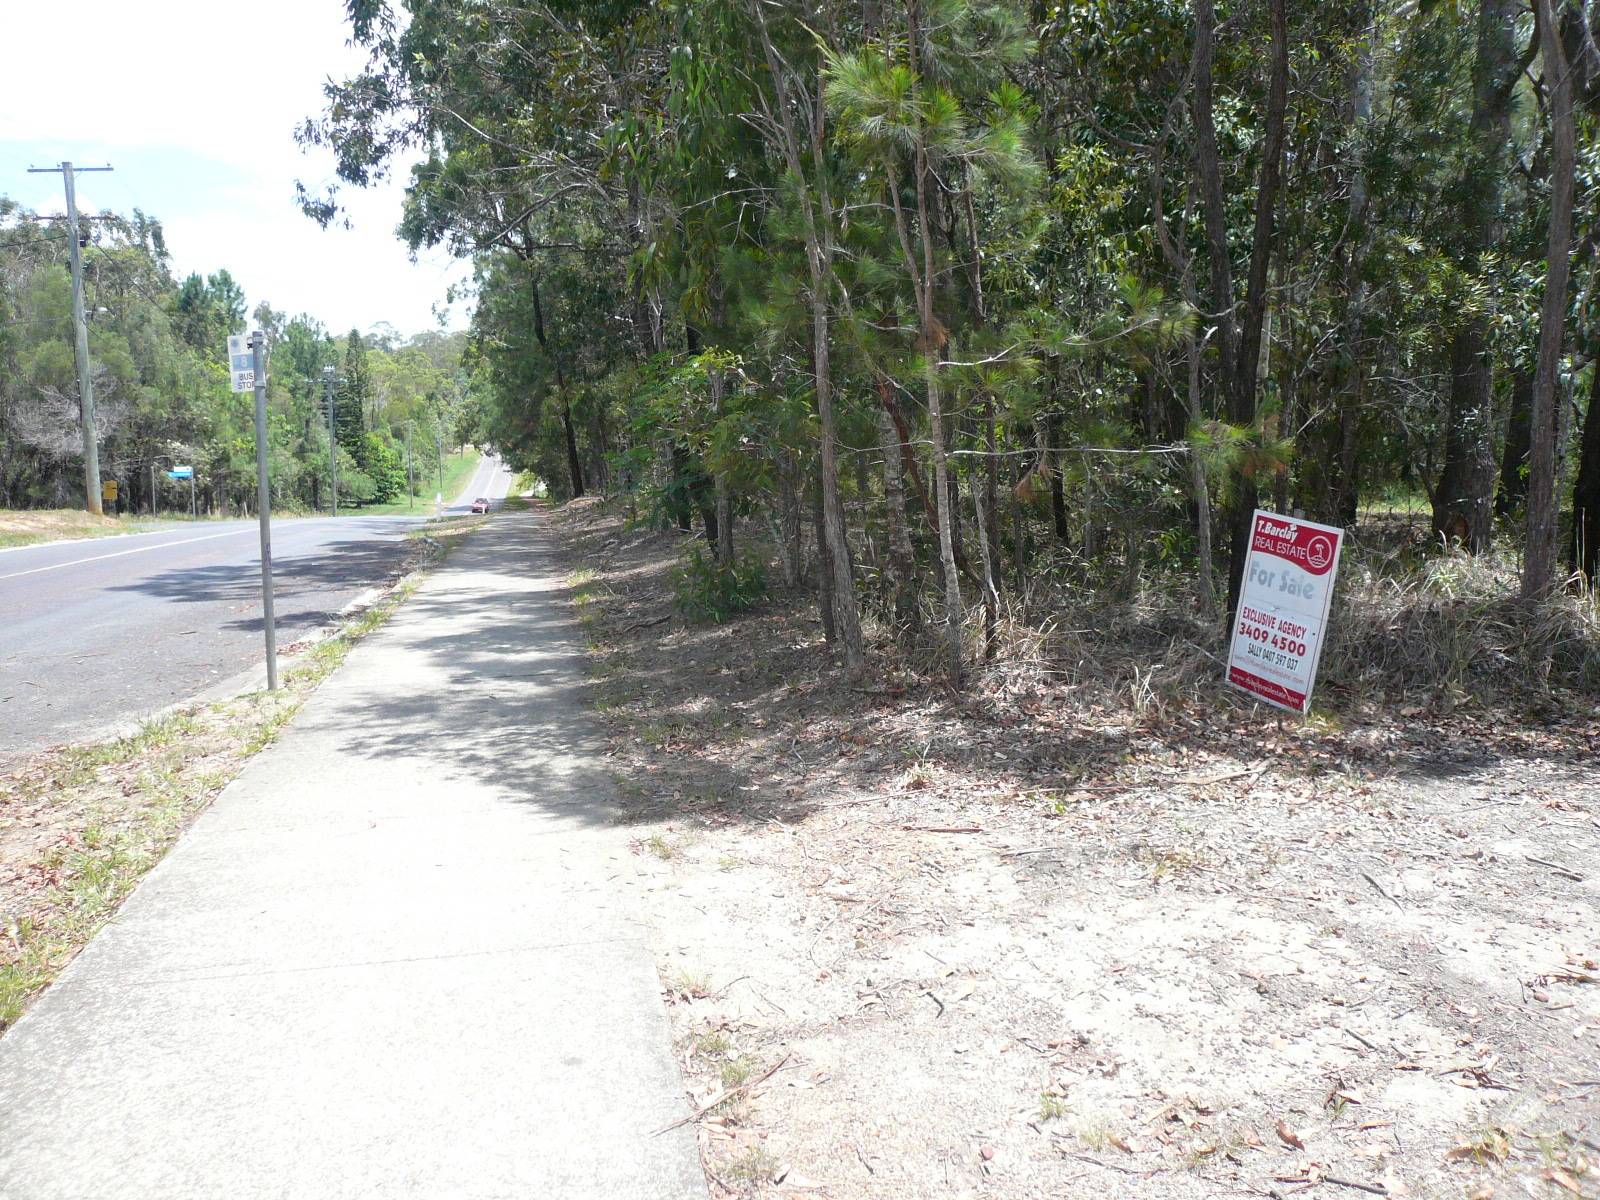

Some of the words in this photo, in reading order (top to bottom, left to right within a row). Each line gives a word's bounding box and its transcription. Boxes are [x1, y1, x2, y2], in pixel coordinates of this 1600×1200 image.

[239, 372, 254, 381] BUS
[1257, 520, 1298, 542] T.Barclay
[1254, 536, 1275, 551] REAL
[1276, 542, 1307, 560] ESTATE
[1249, 560, 1276, 588] For
[1279, 567, 1315, 600] Sale
[1242, 606, 1277, 630] EXCLUSIVE
[1277, 615, 1307, 640] AGENCY
[1239, 622, 1269, 644] 3409
[1271, 635, 1306, 657] 4500
[1247, 643, 1263, 657] SALLY
[1275, 653, 1287, 667] 597
[1286, 657, 1299, 671] 037
